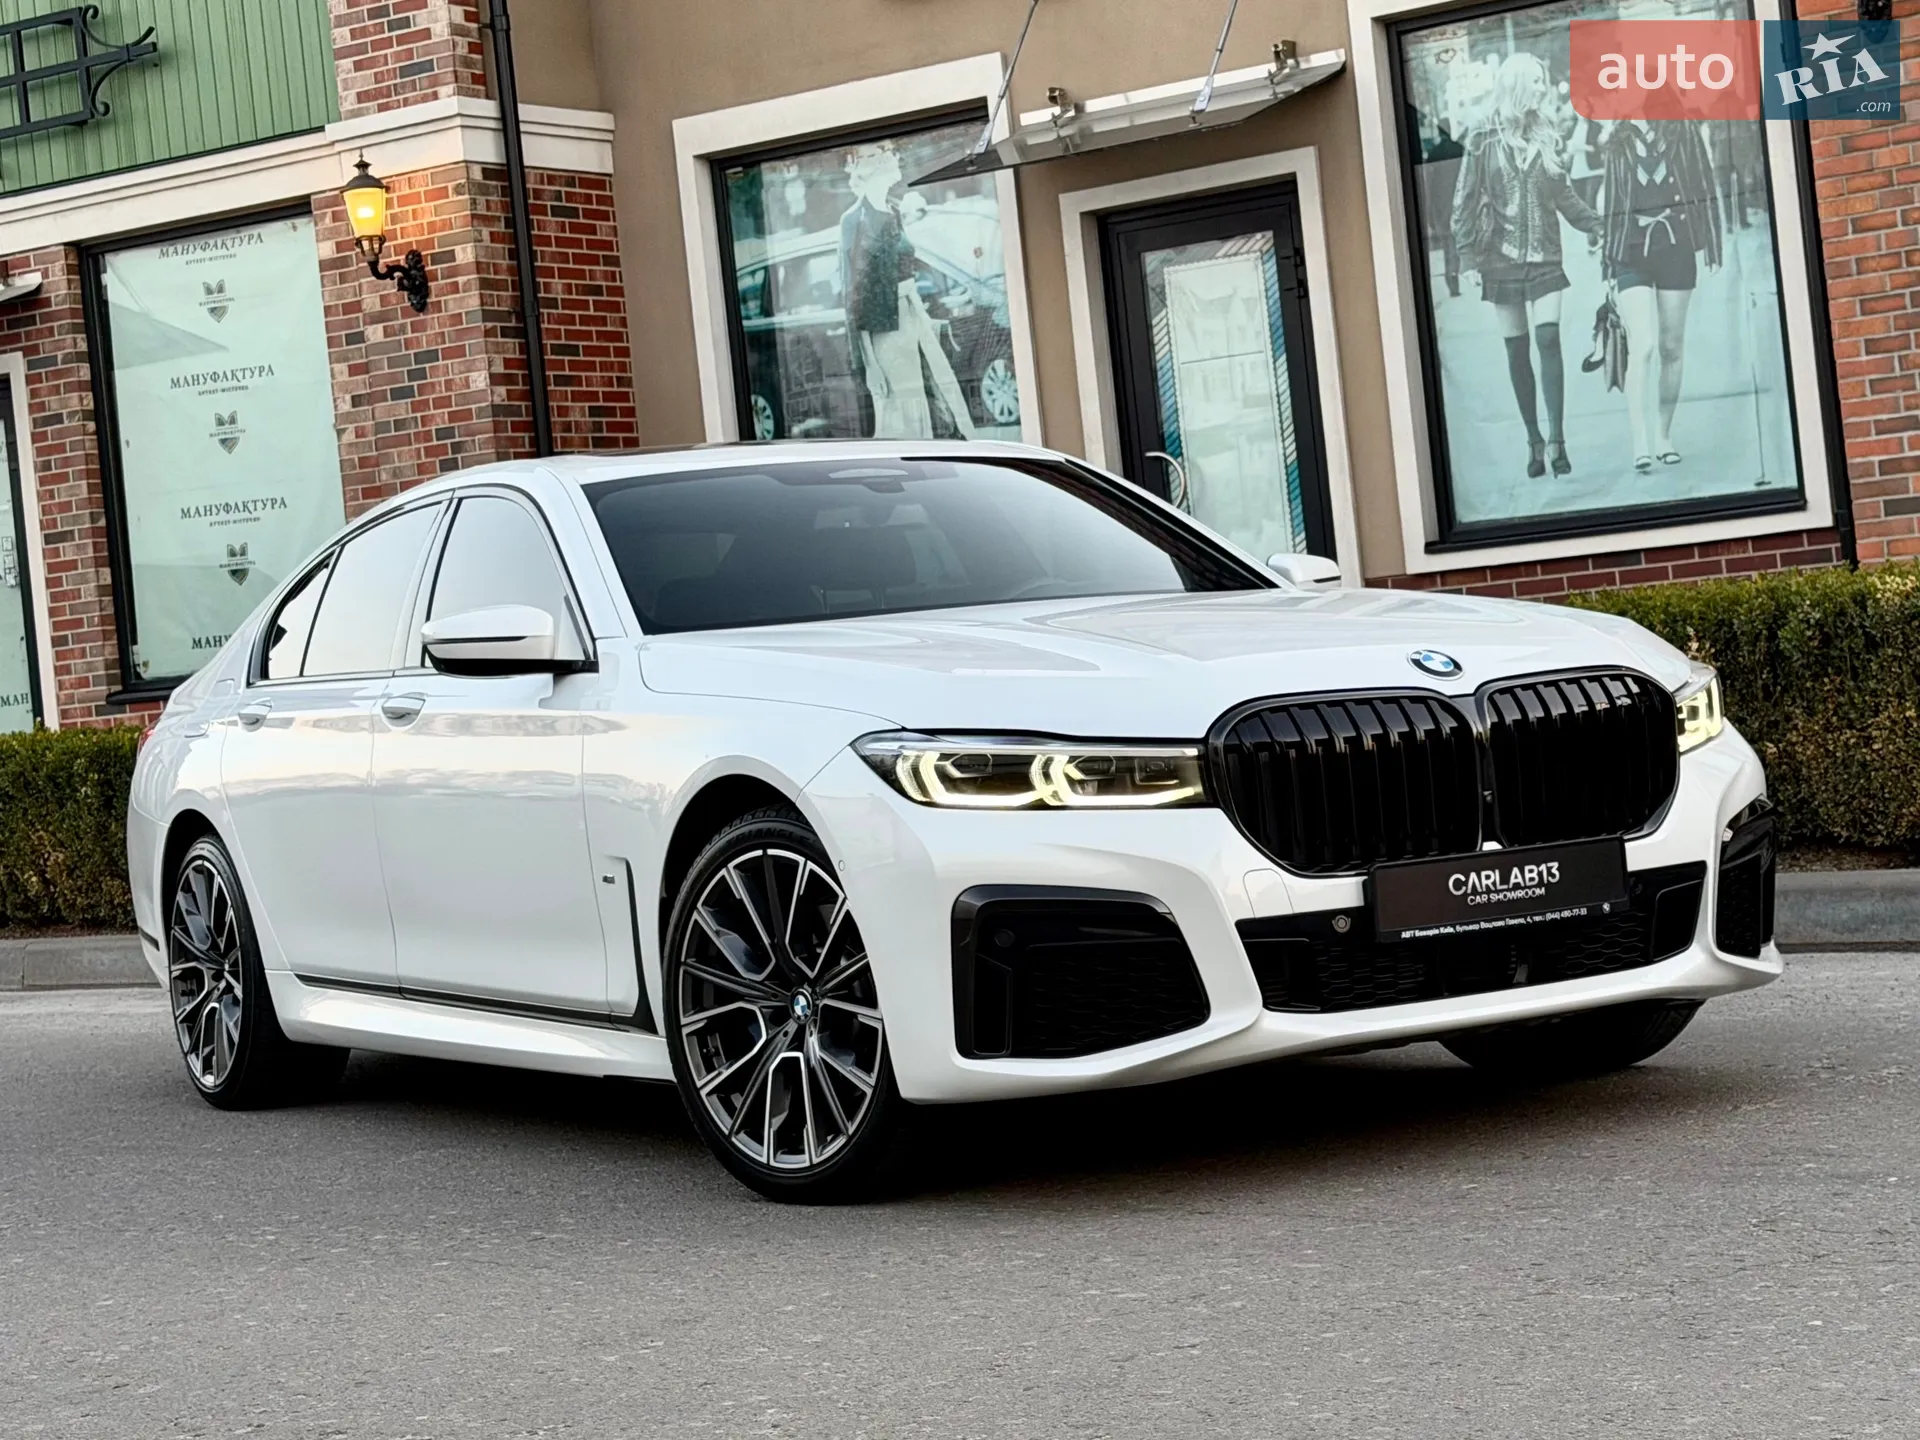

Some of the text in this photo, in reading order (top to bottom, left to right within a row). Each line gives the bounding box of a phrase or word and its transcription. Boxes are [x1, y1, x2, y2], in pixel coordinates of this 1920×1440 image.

[158, 231, 264, 260] МАНУФАКТУРА
[170, 363, 275, 390] МАНУФАКТУРА
[180, 496, 288, 520] МАНУФАКТУРА
[1448, 862, 1560, 896] CARLAB13
[1467, 887, 1546, 906] CAR SHOWROOM
